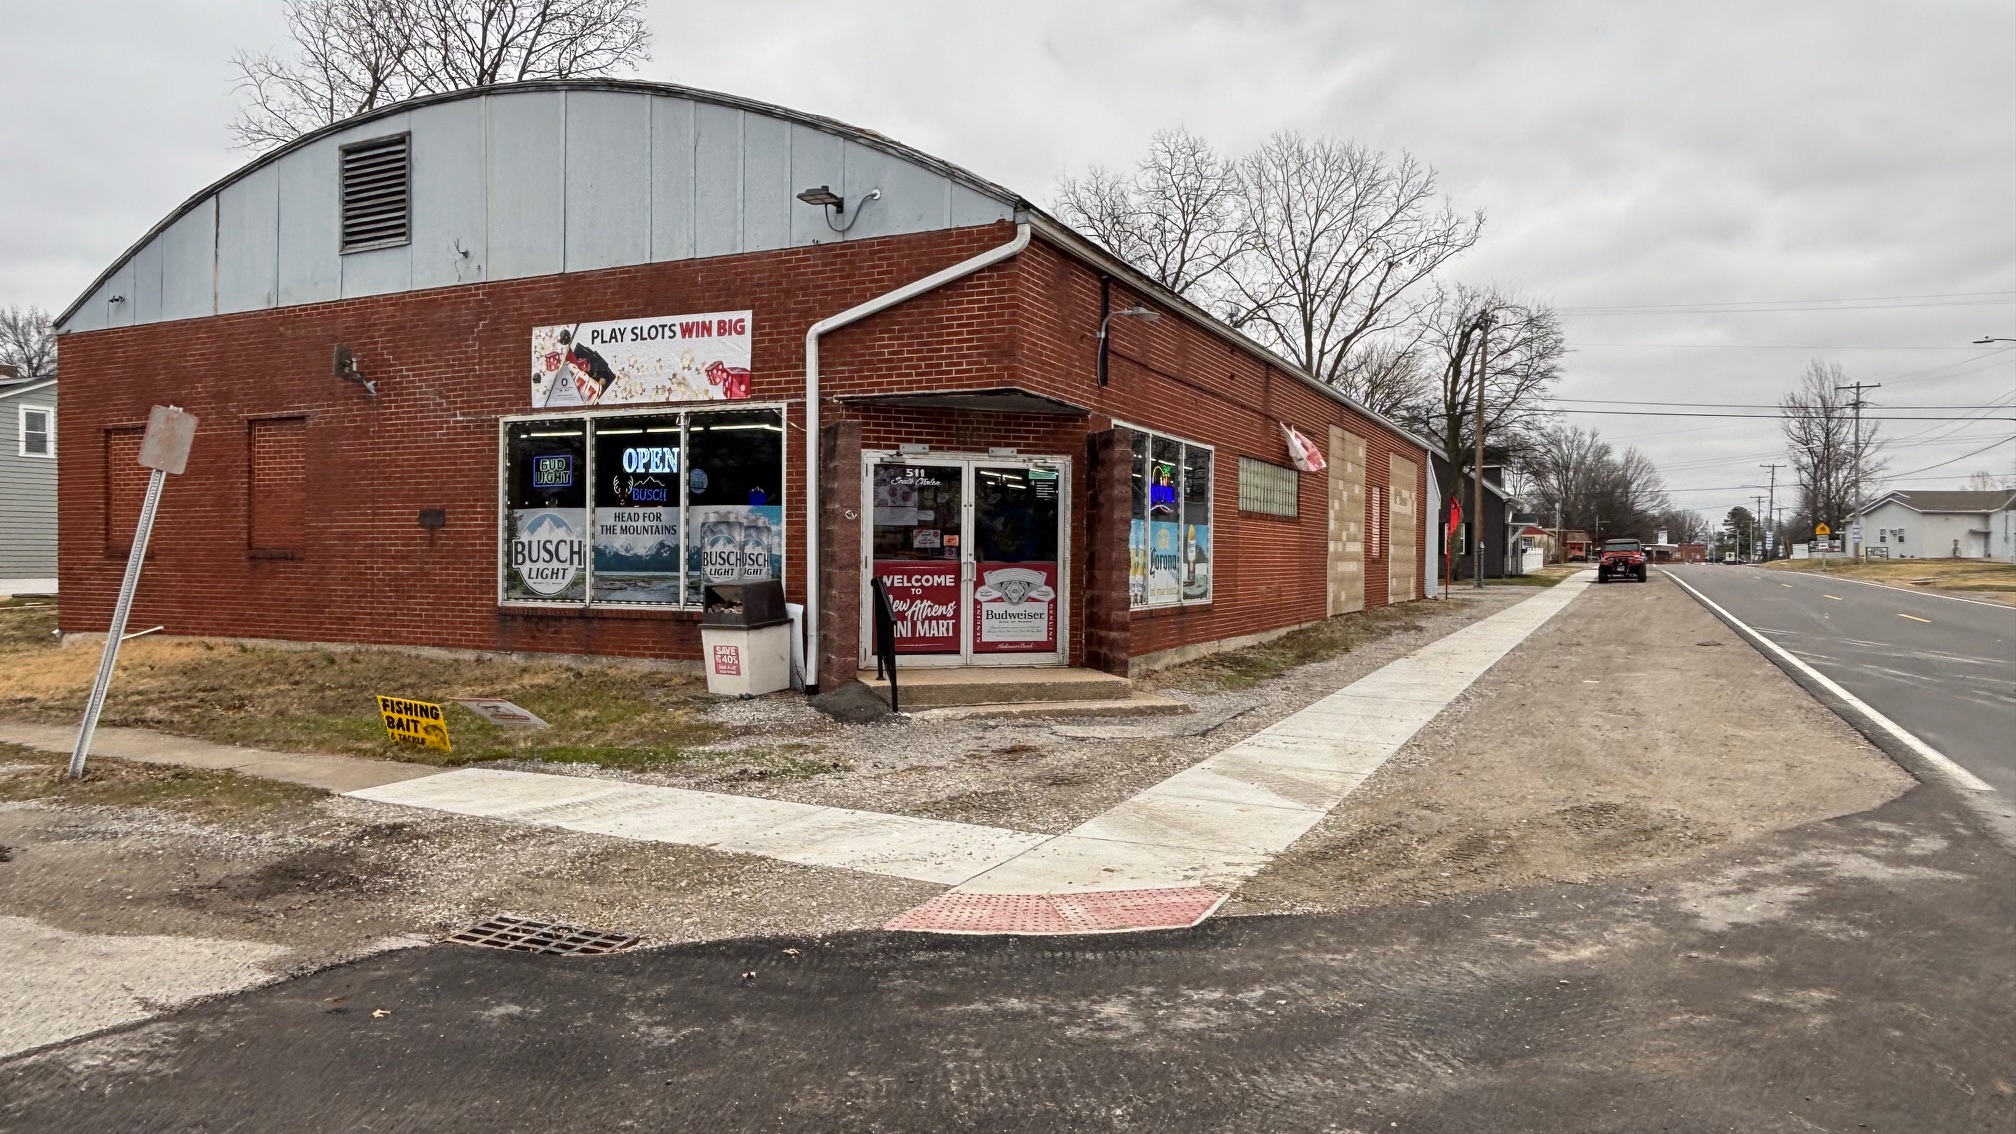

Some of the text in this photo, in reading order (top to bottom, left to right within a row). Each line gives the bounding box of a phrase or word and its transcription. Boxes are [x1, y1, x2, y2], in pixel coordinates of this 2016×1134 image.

[591, 317, 746, 345] PLAY SLOTS WIN BIG
[540, 458, 566, 472] BUD
[622, 447, 680, 474] OPEN
[536, 470, 570, 484] LIGHT
[905, 468, 925, 477] 511
[632, 488, 667, 501] BUSCH
[614, 512, 662, 522] HEAD FOR
[599, 525, 677, 535] THE MOUNTAINS
[513, 539, 583, 566] BUSCH
[703, 551, 741, 567] BUSCH
[741, 552, 768, 567] USCH
[527, 567, 569, 580] LIGHT
[709, 568, 735, 576] LIGHT
[882, 575, 955, 587] WELCOME
[905, 599, 957, 622] Athens
[985, 609, 1045, 620] Budweiser
[916, 620, 955, 637] MART
[715, 646, 736, 656] SAVE
[381, 698, 440, 720] FISHING
[385, 715, 420, 734] BAIT
